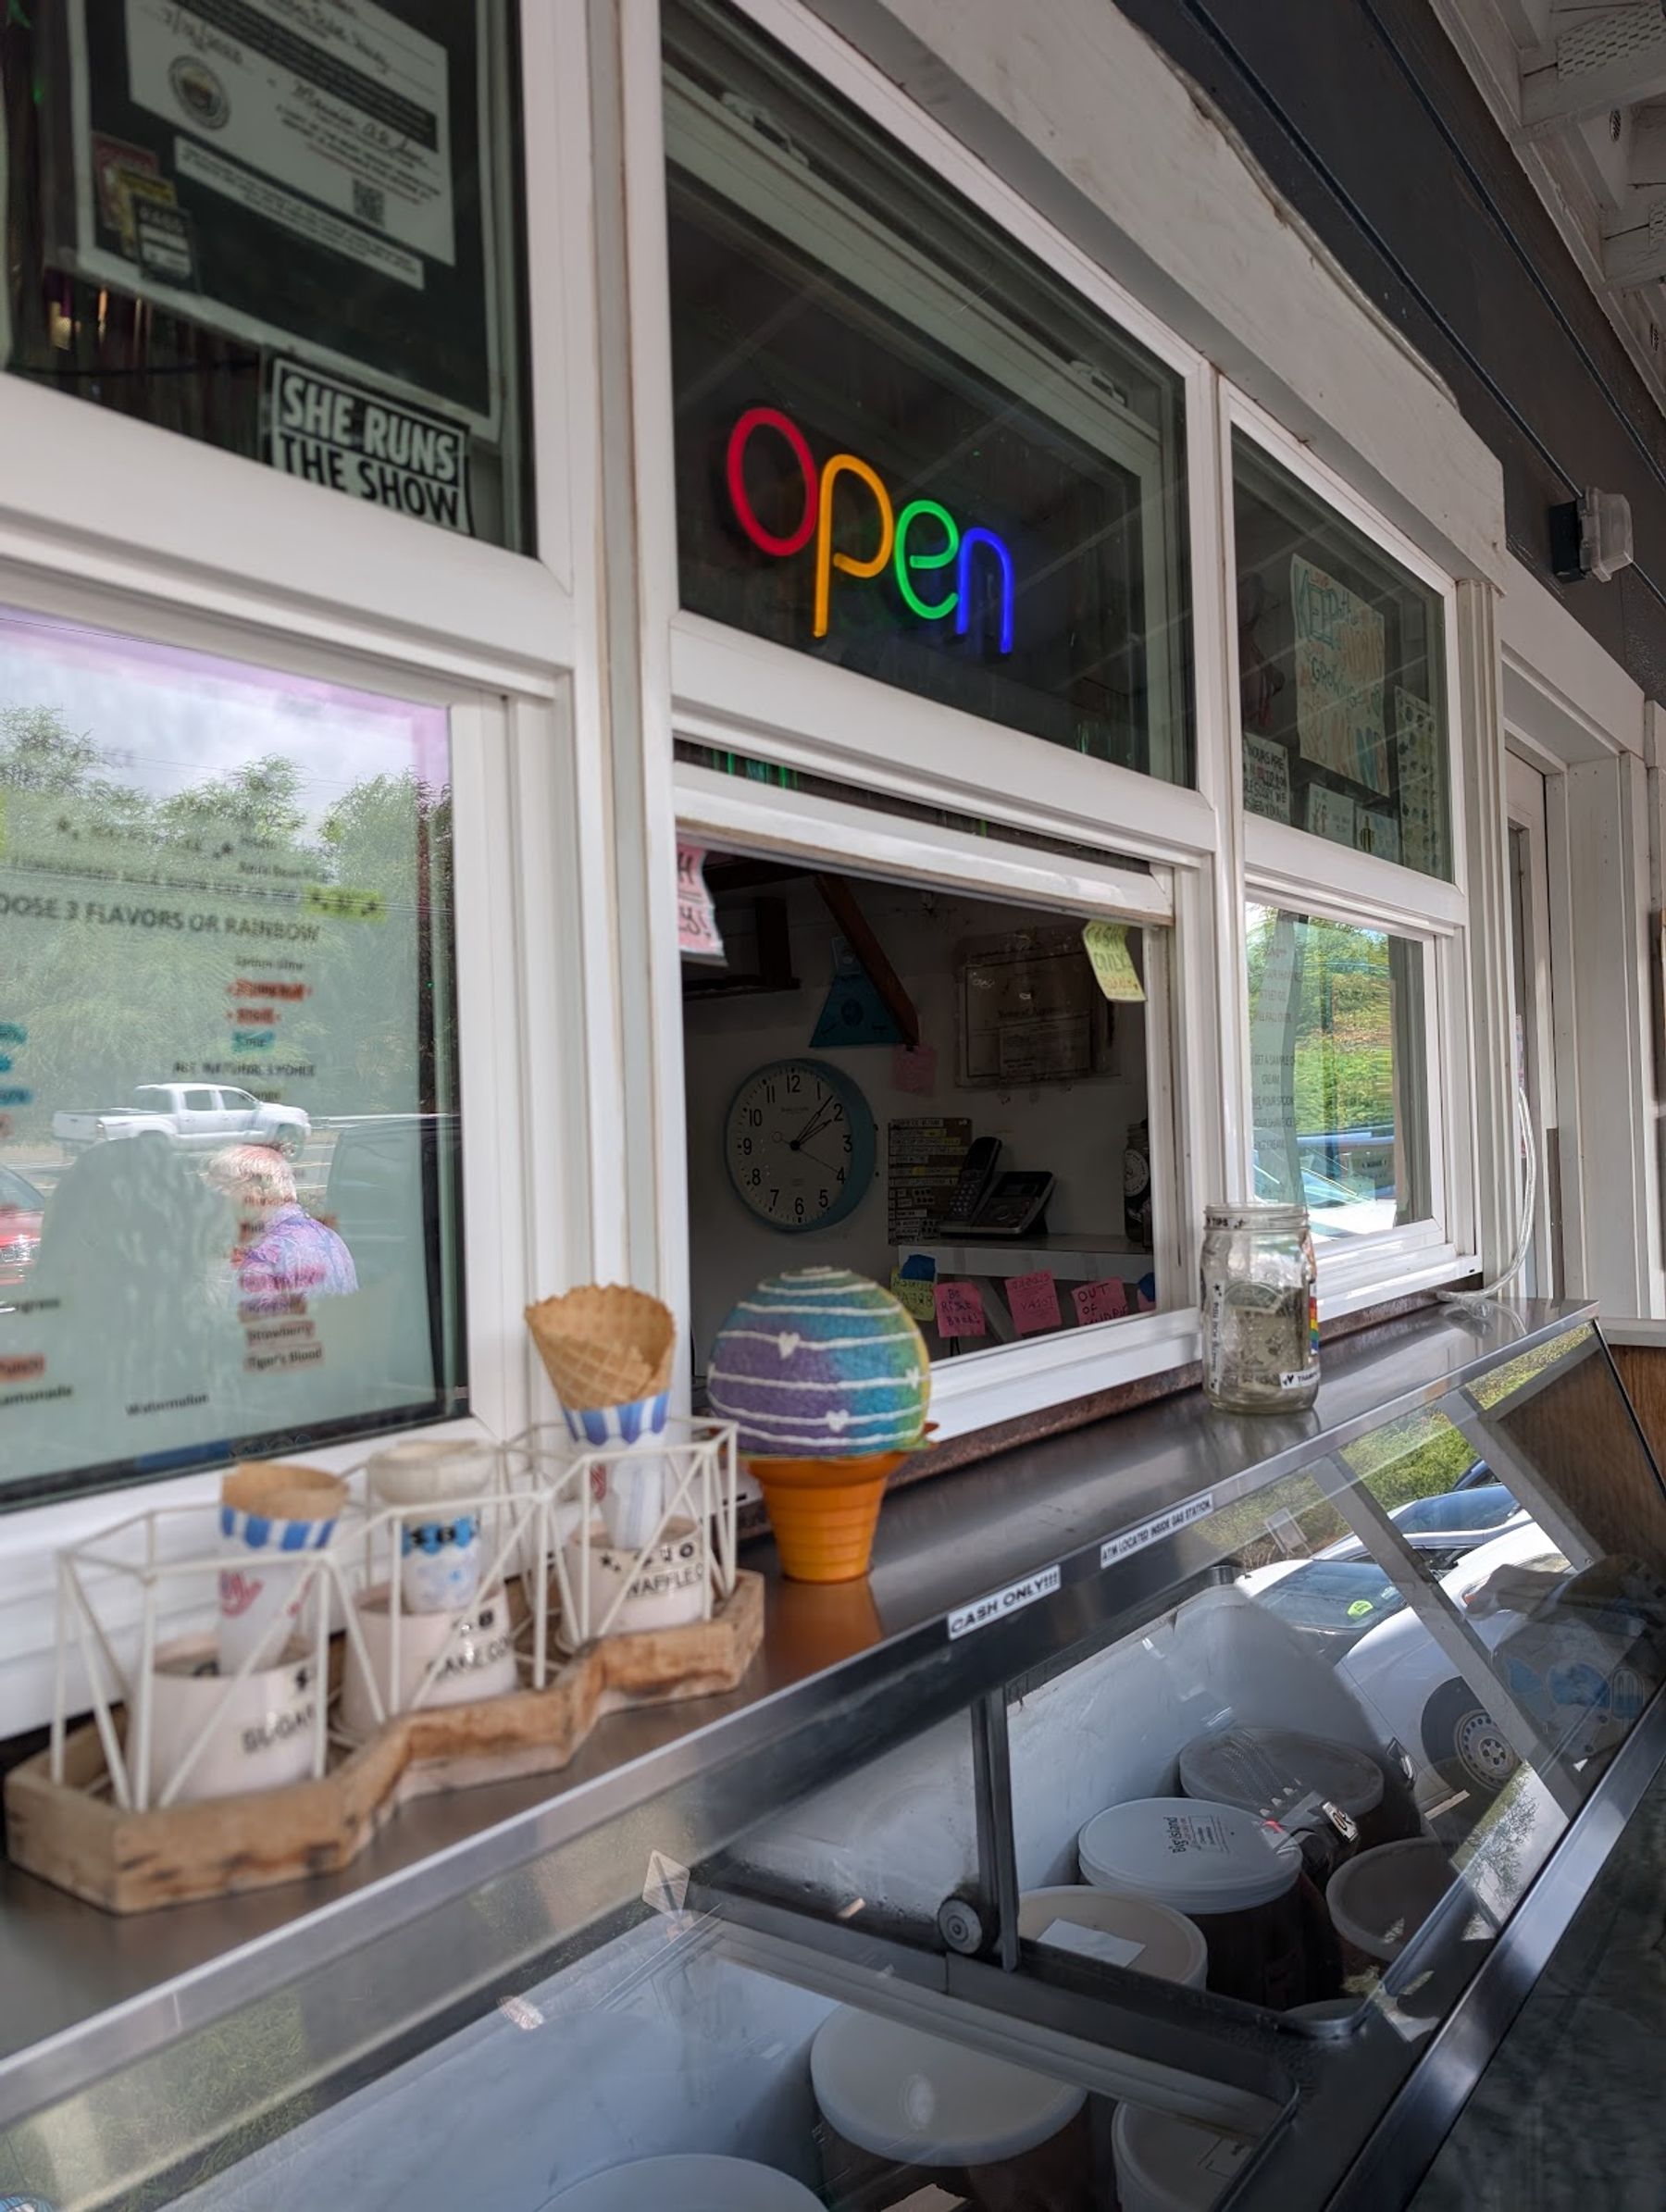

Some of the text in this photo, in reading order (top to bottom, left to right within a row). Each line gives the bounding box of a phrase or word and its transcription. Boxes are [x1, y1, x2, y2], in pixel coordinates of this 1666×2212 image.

[282, 374, 454, 480] SHE RUNS
[280, 432, 458, 528] THE SHOW
[727, 407, 1014, 654] Open
[86, 902, 183, 930] FLAVORS
[190, 913, 219, 932] OR
[225, 917, 321, 941] RAINBOW
[786, 1075, 801, 1093] 12
[816, 1081, 822, 1100] 1
[766, 1085, 776, 1103] 11
[749, 1109, 763, 1126] 10
[834, 1103, 844, 1122] 2
[743, 1137, 752, 1155] 9
[843, 1135, 852, 1152] 3
[752, 1168, 762, 1186] 8
[836, 1166, 846, 1184] 4
[770, 1189, 779, 1207] 7
[795, 1198, 804, 1215] 6
[819, 1189, 828, 1208] 5
[1078, 1283, 1110, 1302] OUT
[126, 1393, 209, 1417] Watermelon
[1119, 1530, 1149, 1552] LOCATED
[1150, 1520, 1171, 1538] INSIDE
[1172, 1513, 1185, 1526] GAS
[1186, 1500, 1212, 1521] STATION
[951, 1573, 1059, 1634] CASH ONLY!!!
